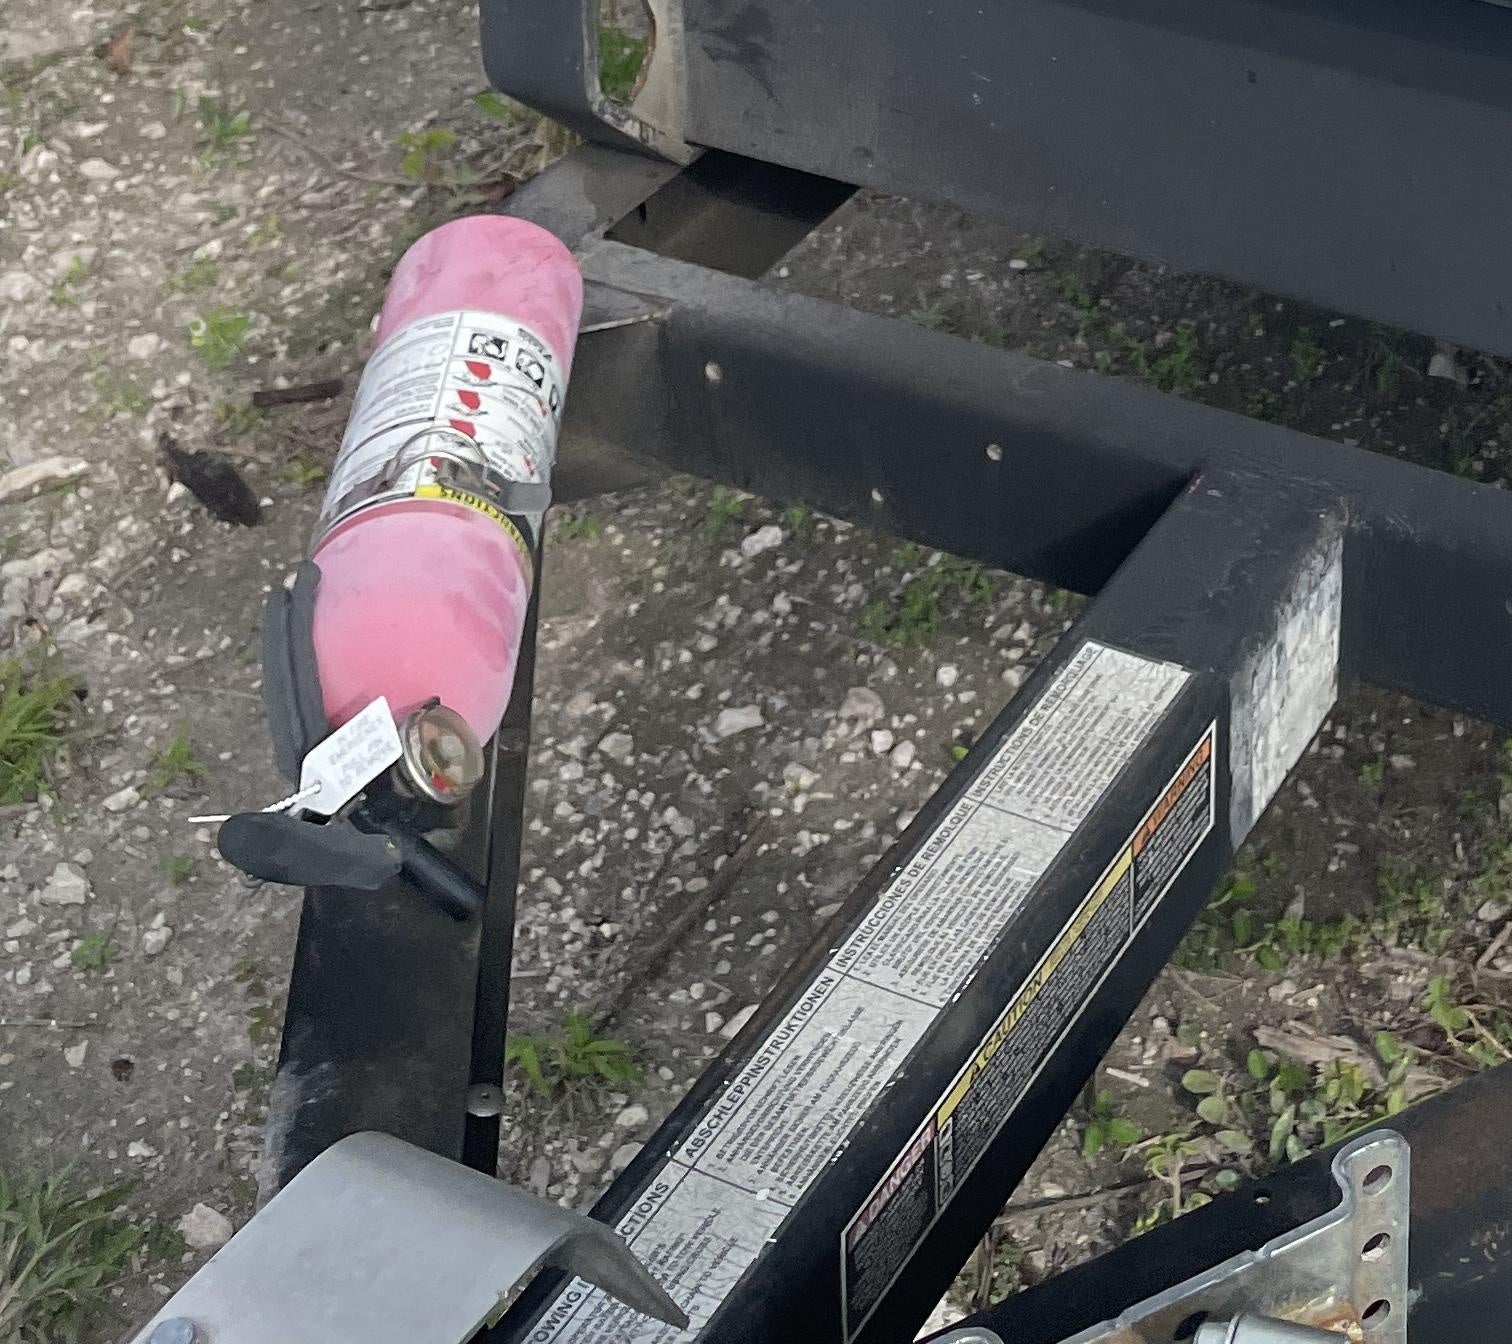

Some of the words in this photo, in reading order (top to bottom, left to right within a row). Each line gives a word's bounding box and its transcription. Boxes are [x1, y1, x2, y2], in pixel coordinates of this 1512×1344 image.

[1025, 710, 1047, 727] DE
[831, 877, 914, 968] INSTRUCCIONES
[905, 861, 928, 878] DE
[918, 801, 976, 862] REMOLQUE
[678, 975, 837, 1159] ABSCHLEPPINSTRUKTIONEN
[983, 968, 1042, 1065] CAUTION
[868, 1121, 931, 1227] DANGER
